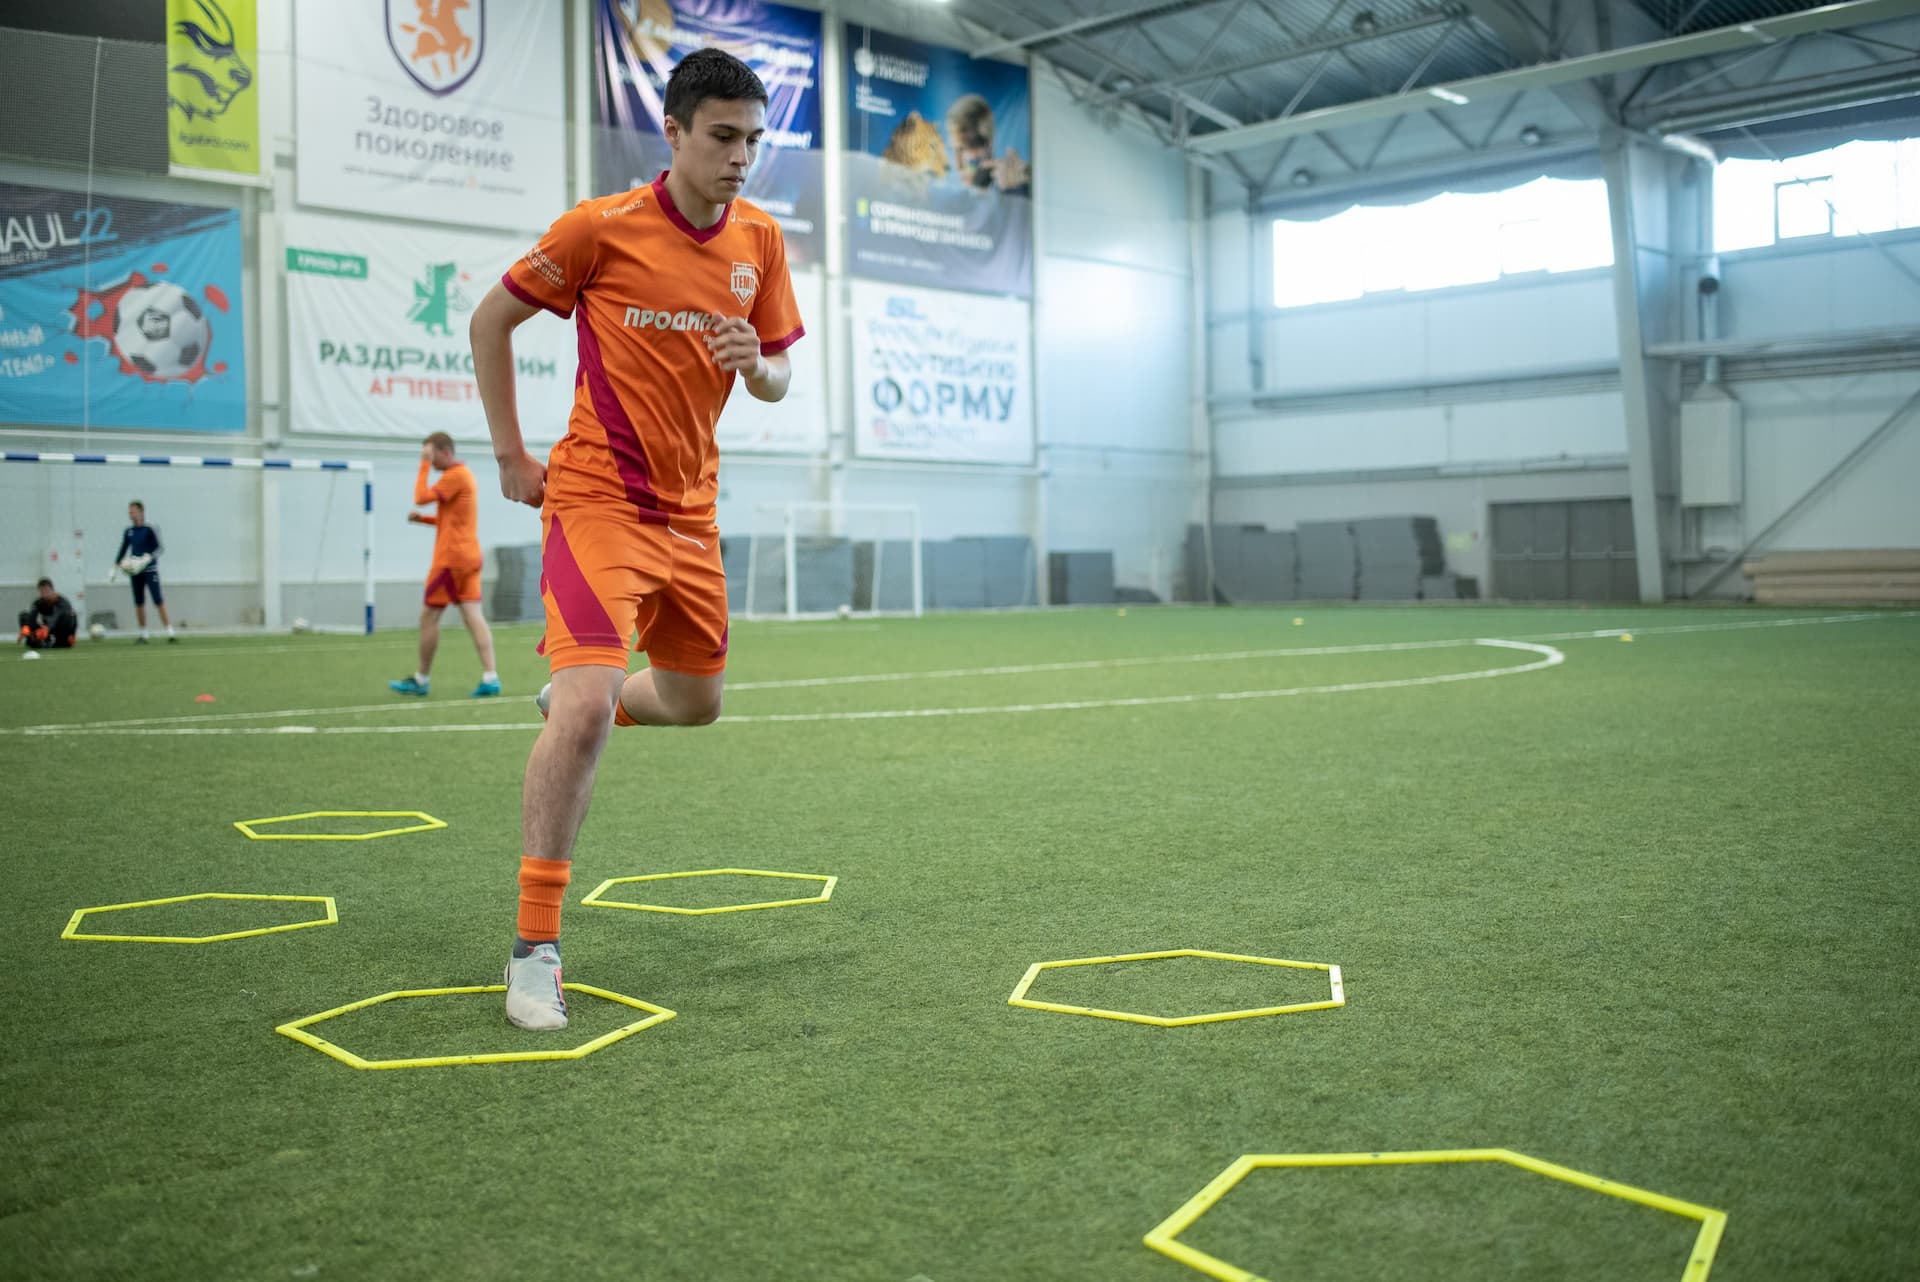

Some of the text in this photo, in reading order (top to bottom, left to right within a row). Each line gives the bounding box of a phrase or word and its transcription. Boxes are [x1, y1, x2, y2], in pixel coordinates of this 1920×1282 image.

[366, 95, 505, 142] Здоровое
[354, 130, 515, 173] поколение
[528, 254, 566, 287] коление
[733, 274, 755, 291] ТЕМП
[623, 305, 714, 332] ПРОДИН
[320, 342, 558, 379] РАЗДРАКОИМ
[368, 375, 480, 402] АППЕТ
[872, 376, 1015, 423] ФОРМУ
